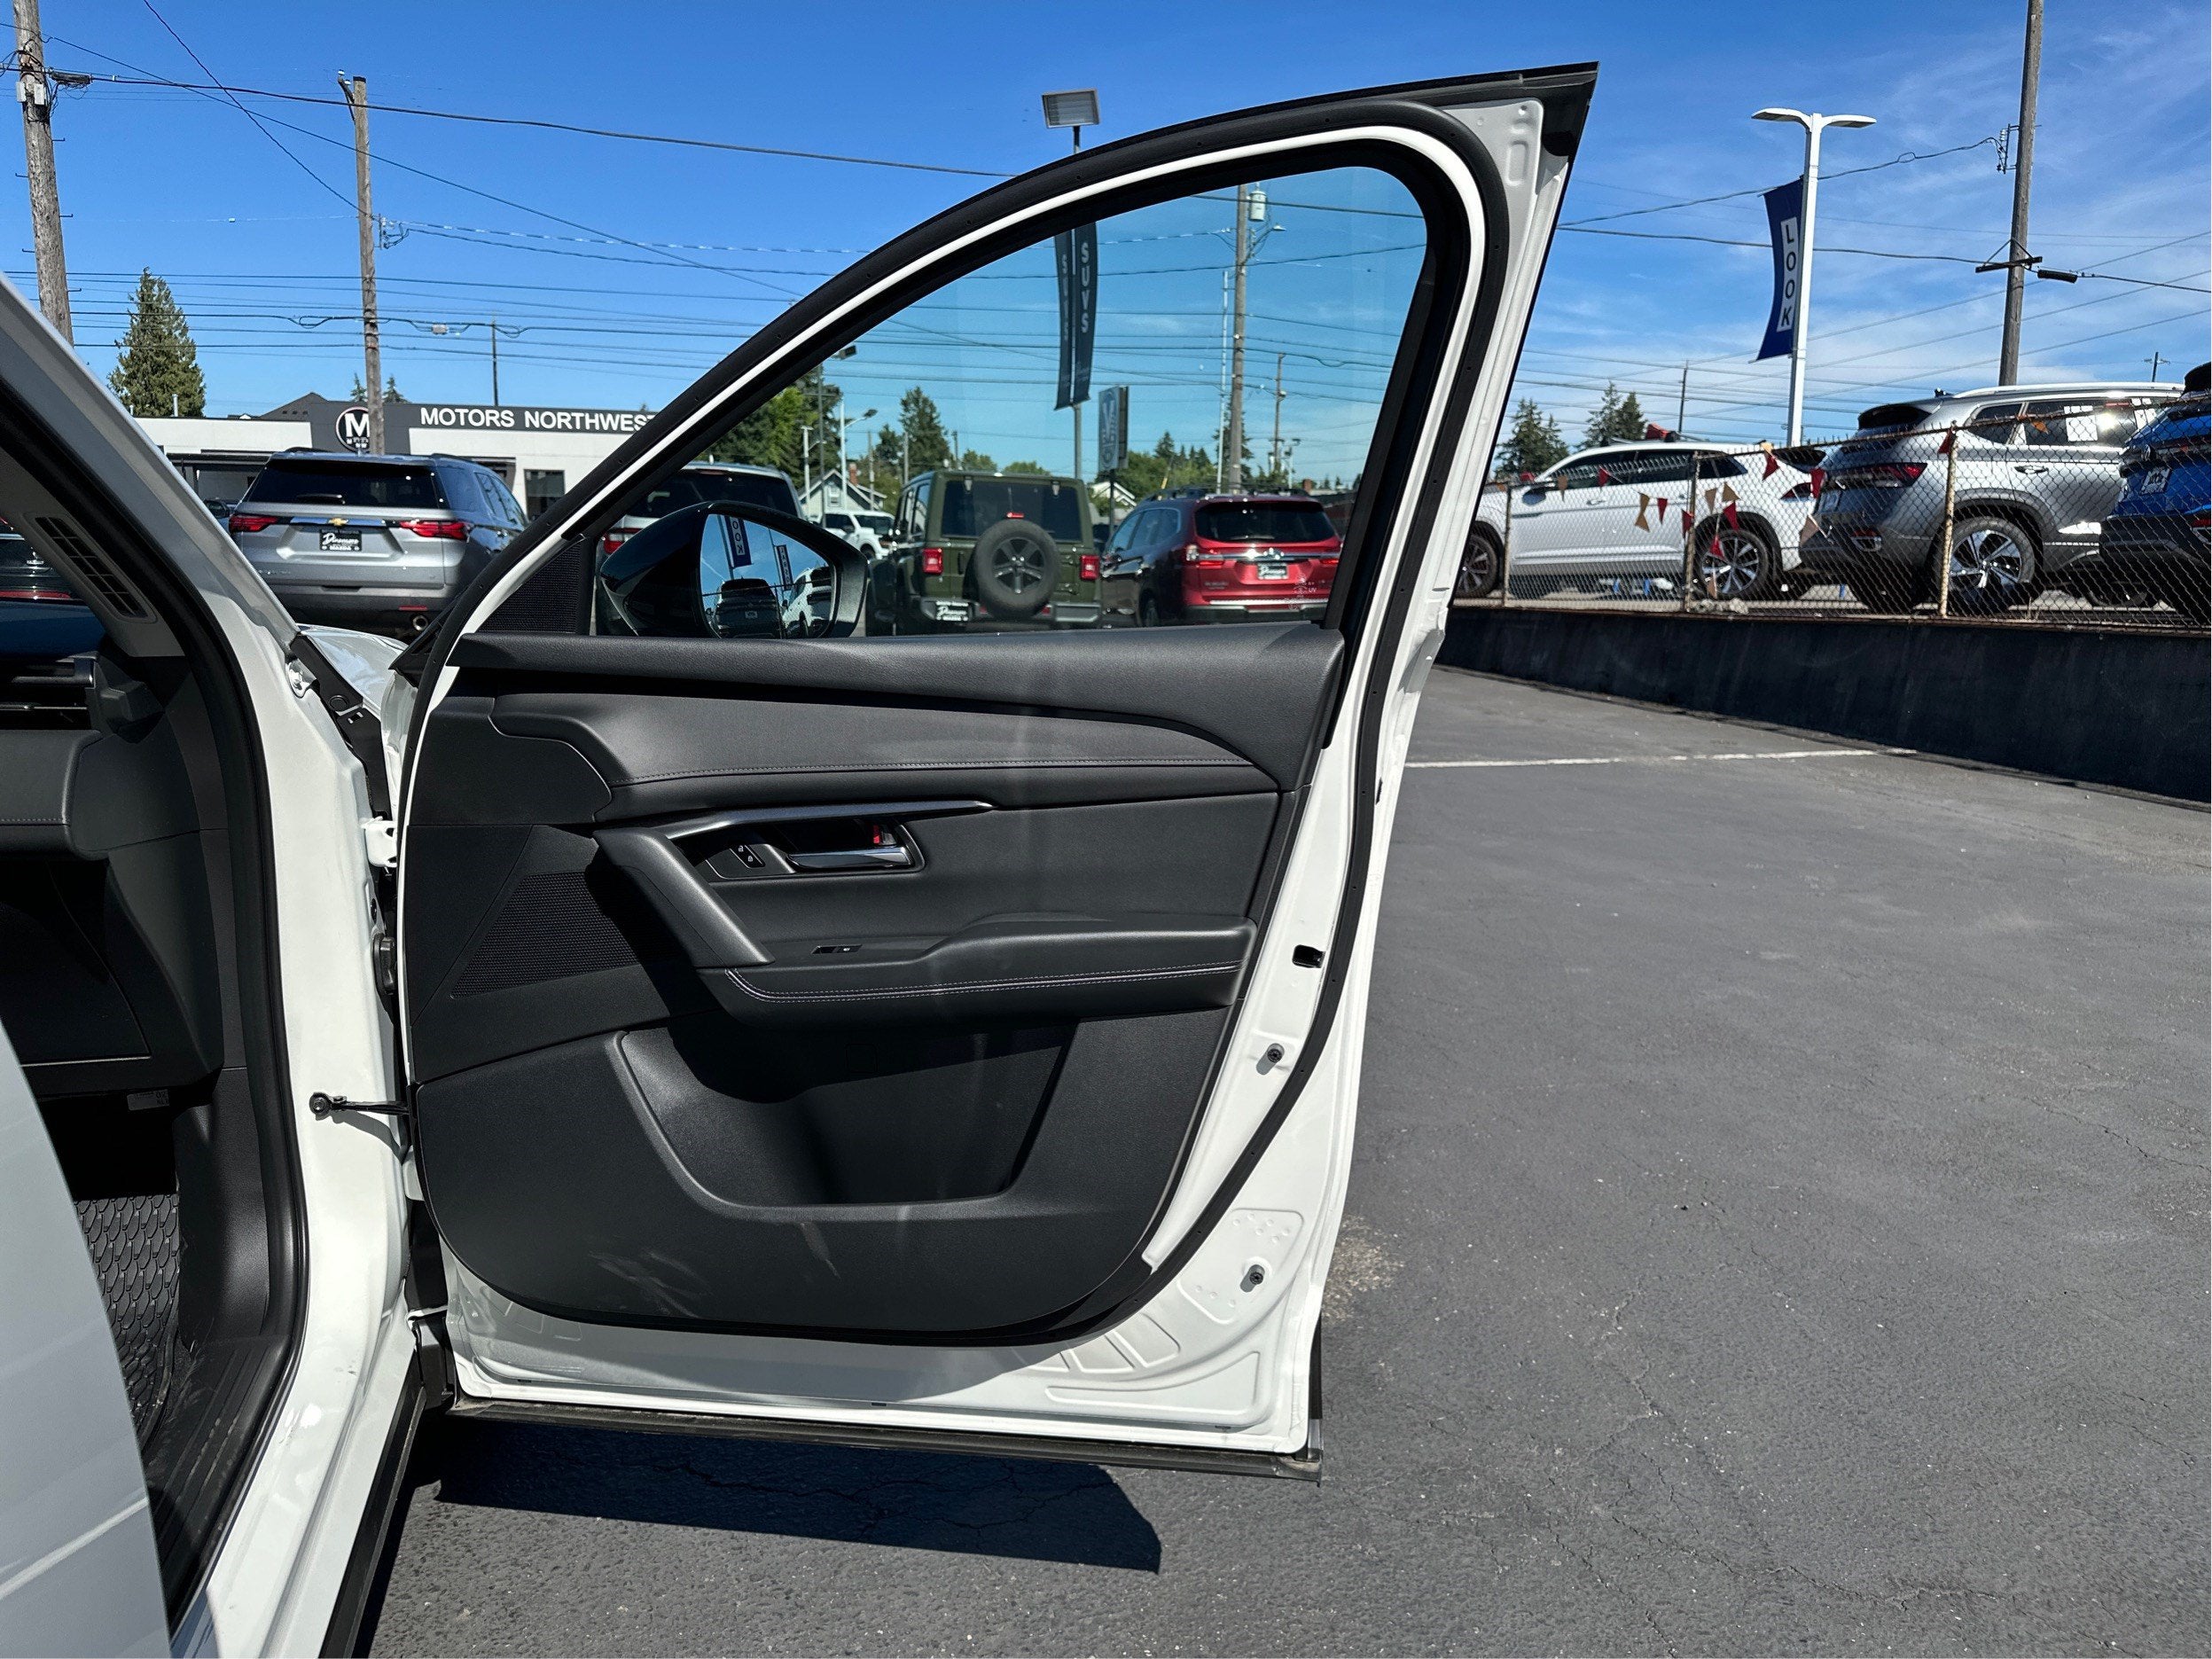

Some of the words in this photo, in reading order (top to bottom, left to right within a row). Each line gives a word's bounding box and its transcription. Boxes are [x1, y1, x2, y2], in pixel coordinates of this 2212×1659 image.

[1081, 241, 1090, 333] SUVS
[1781, 224, 1797, 327] LOOK
[345, 412, 371, 438] M
[420, 407, 515, 428] MOTORS
[524, 411, 656, 433] NORTHWES
